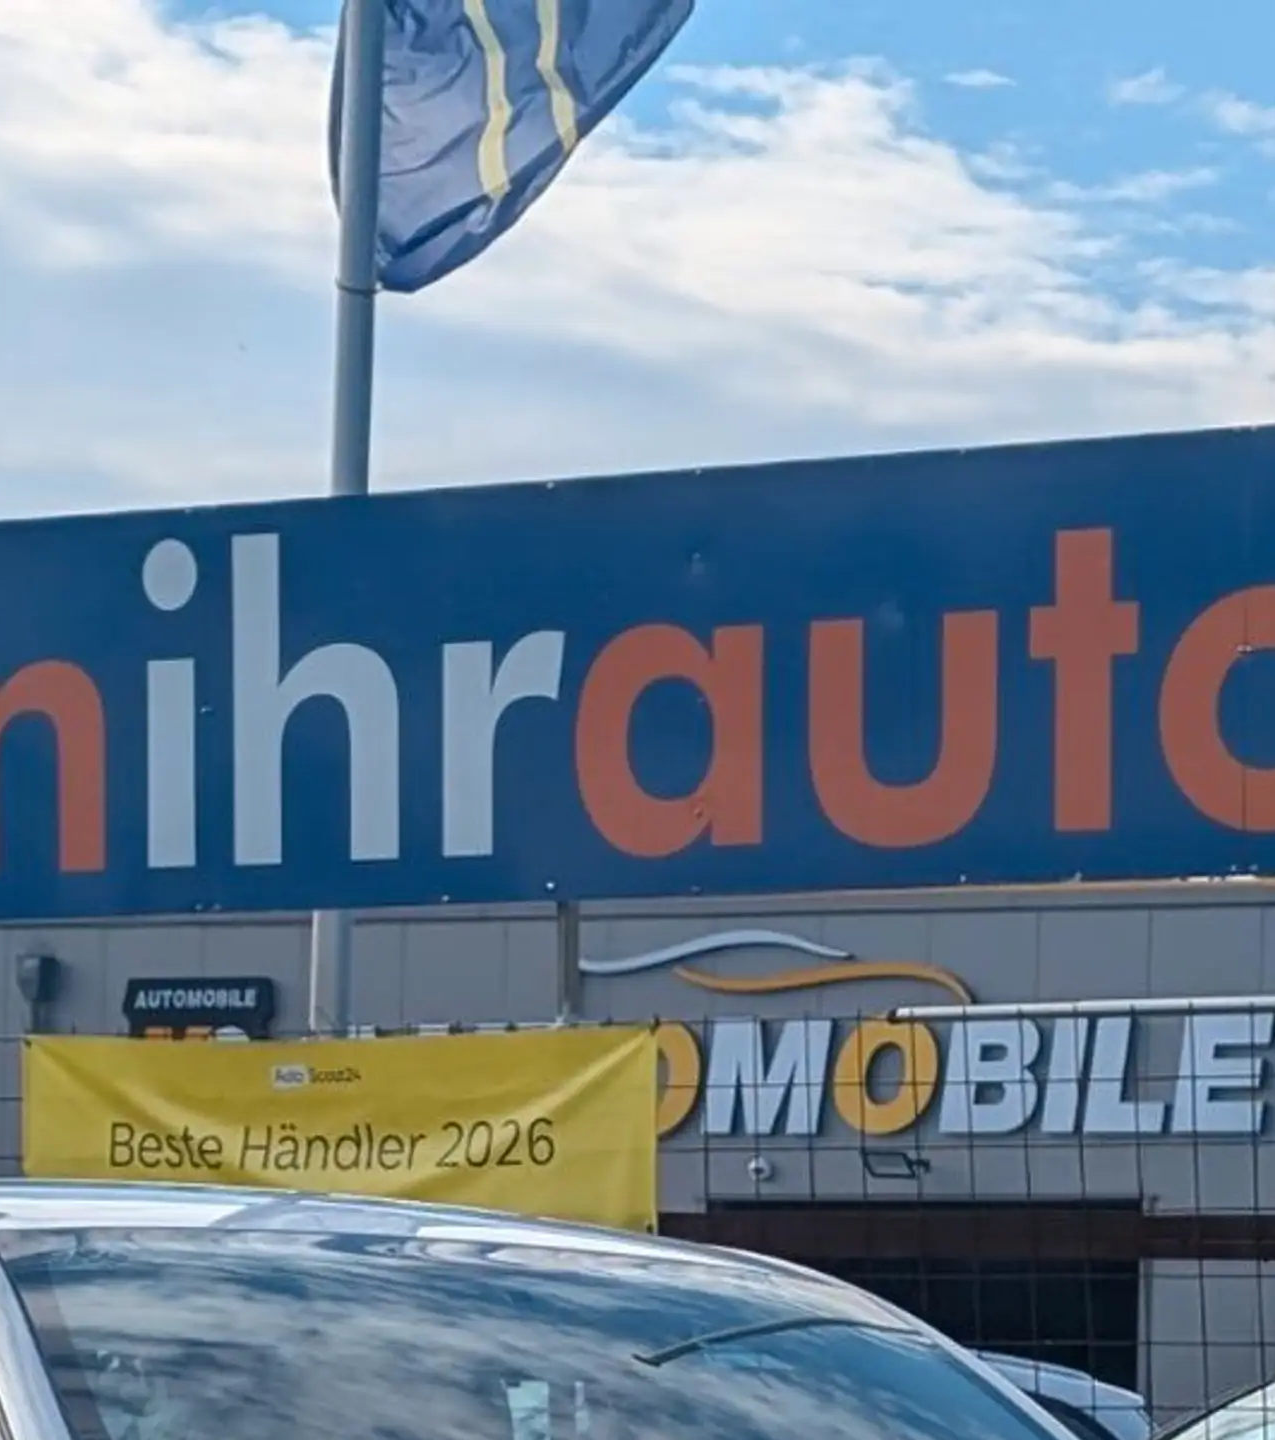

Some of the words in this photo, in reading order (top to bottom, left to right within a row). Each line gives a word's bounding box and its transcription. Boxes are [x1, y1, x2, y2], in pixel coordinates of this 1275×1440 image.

[134, 987, 258, 1009] AUTOMOBILE
[108, 1120, 223, 1170] Beste
[237, 1121, 428, 1172] Händler
[435, 1117, 557, 1169] 2026
